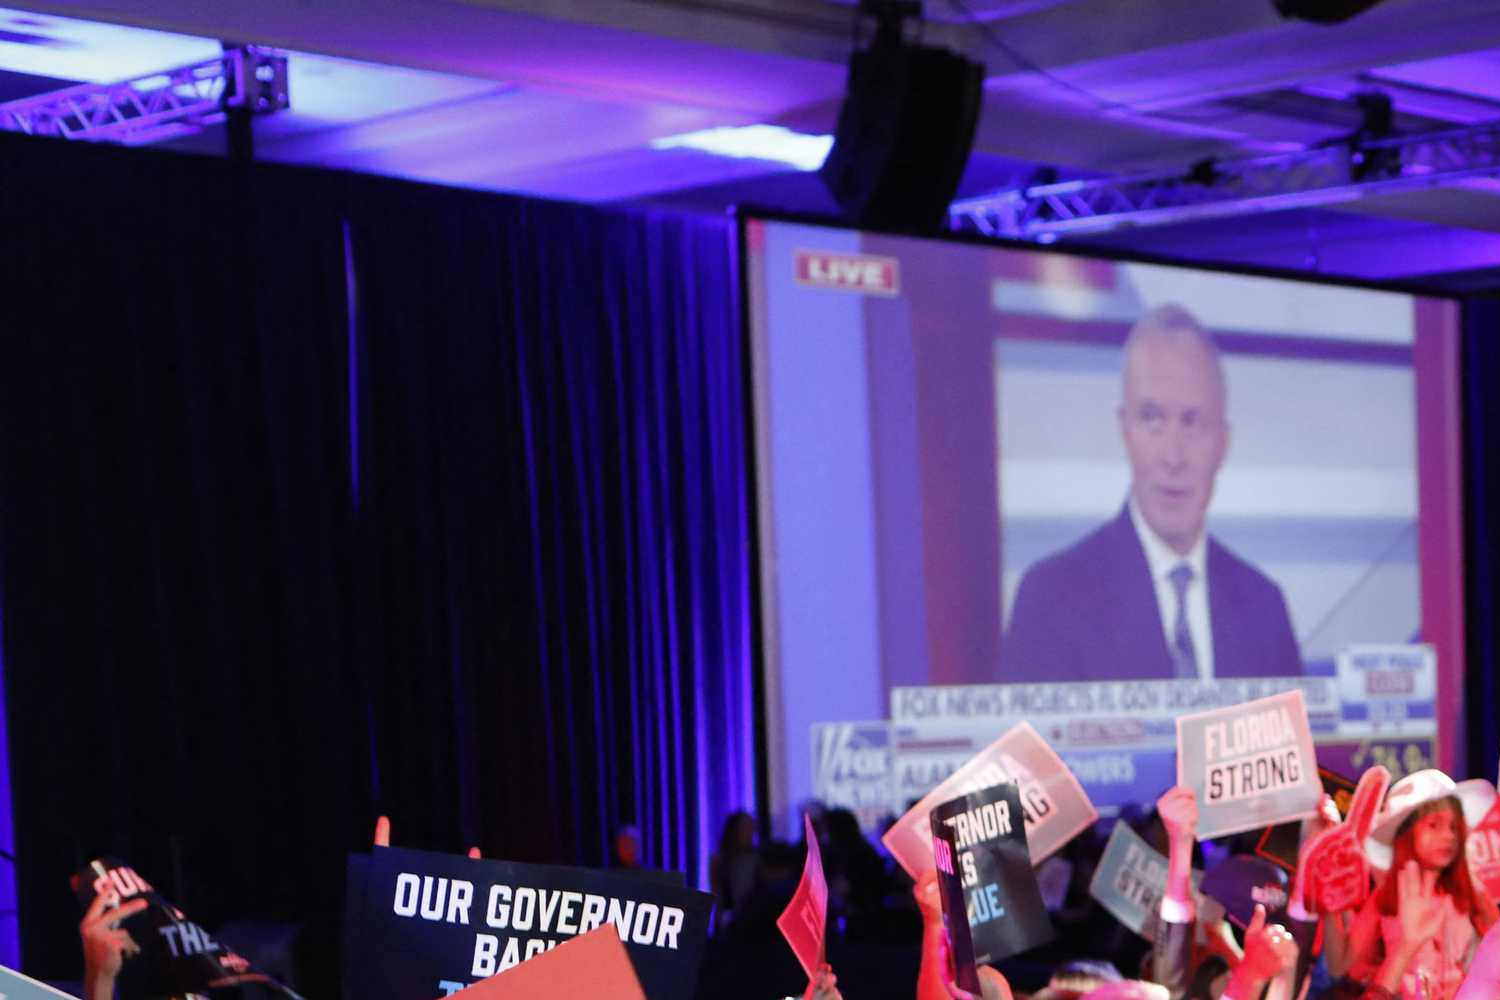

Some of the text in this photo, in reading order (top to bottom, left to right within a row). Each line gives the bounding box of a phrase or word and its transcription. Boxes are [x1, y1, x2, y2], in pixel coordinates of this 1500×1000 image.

[808, 255, 885, 286] LIVE
[1204, 707, 1297, 761] FLORIDA
[1210, 750, 1301, 799] STRONG
[393, 872, 685, 950] OUR GOVERNOR
